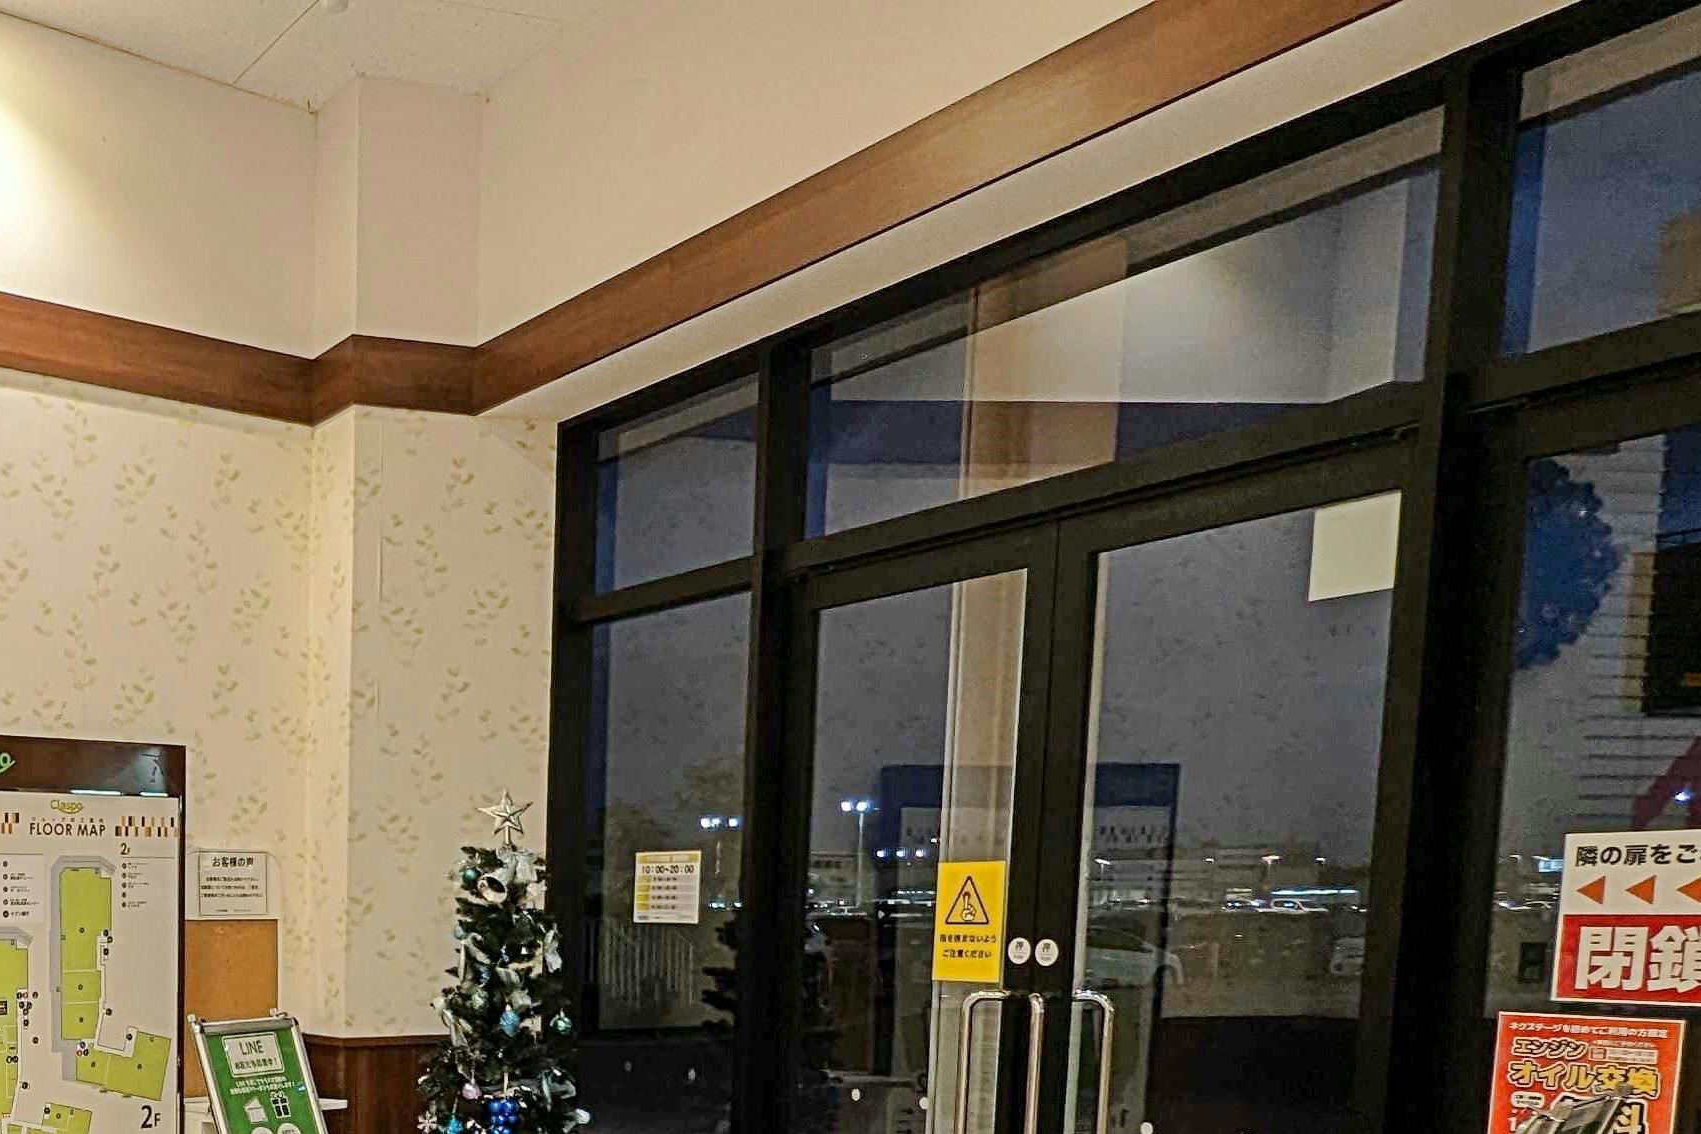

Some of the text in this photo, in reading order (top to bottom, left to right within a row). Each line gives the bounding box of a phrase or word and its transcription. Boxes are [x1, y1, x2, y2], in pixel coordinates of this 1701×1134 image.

[50, 799, 85, 815] Claspo
[29, 822, 106, 836] FLOOR MAP
[1575, 843, 1701, 867] 隣の扉をご
[239, 1040, 264, 1056] LINE
[1512, 1037, 1589, 1059] エンジン
[141, 1105, 162, 1129] 2F
